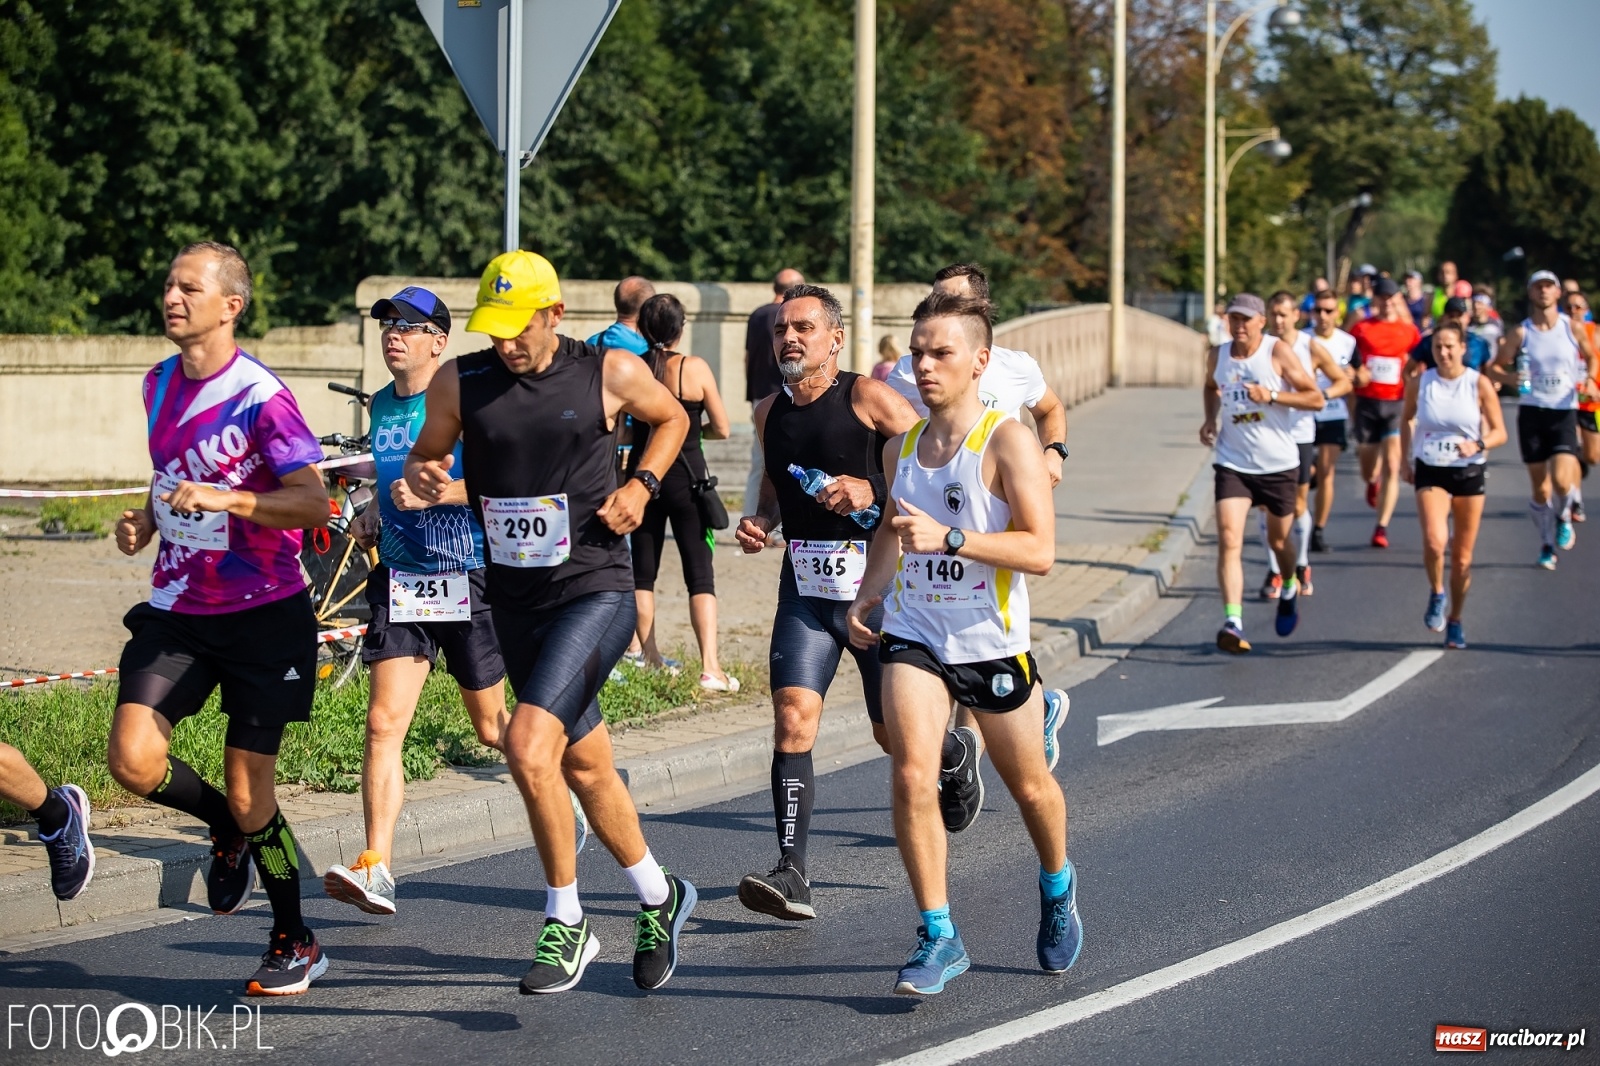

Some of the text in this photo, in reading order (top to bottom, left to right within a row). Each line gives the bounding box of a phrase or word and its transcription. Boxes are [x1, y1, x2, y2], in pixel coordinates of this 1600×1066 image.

[375, 420, 416, 453] bbl
[504, 516, 547, 539] 290
[811, 556, 846, 577] 365
[925, 558, 965, 582] 140
[414, 579, 448, 598] 251
[781, 778, 805, 847] kalenji
